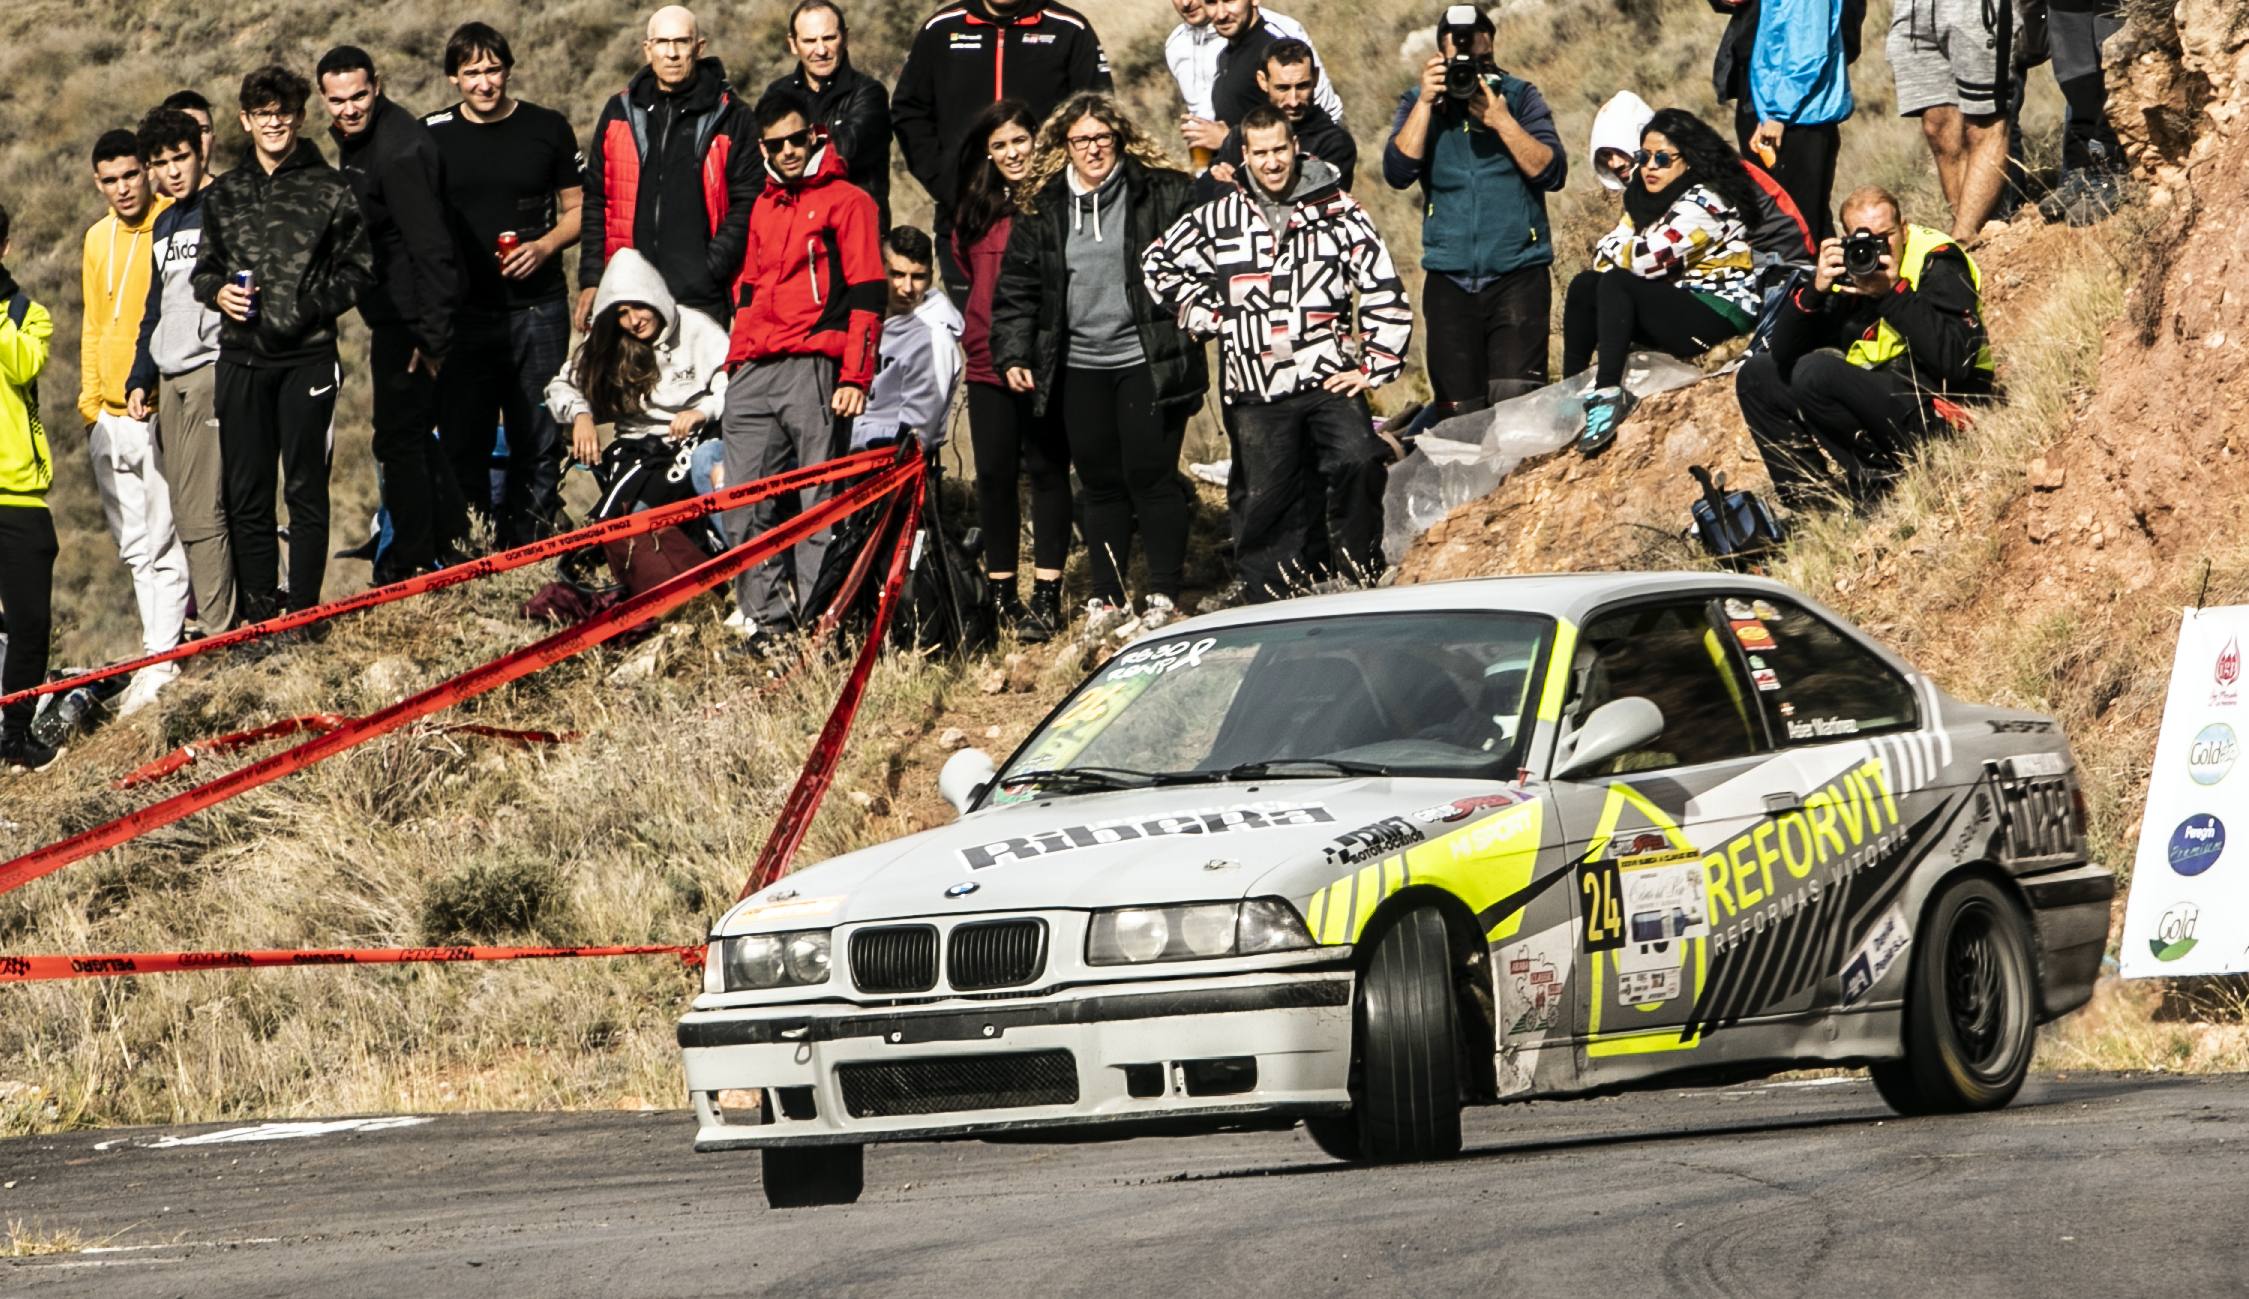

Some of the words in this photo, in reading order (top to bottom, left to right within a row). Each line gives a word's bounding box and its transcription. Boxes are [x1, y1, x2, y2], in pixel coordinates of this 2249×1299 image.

[1702, 757, 1899, 926] REFORVIT
[1583, 869, 1622, 942] 24
[1714, 879, 1821, 955] REFORMAS
[1831, 824, 1909, 886] VITORIA
[2158, 909, 2199, 940] Gold
[72, 958, 136, 973] PELIGRO
